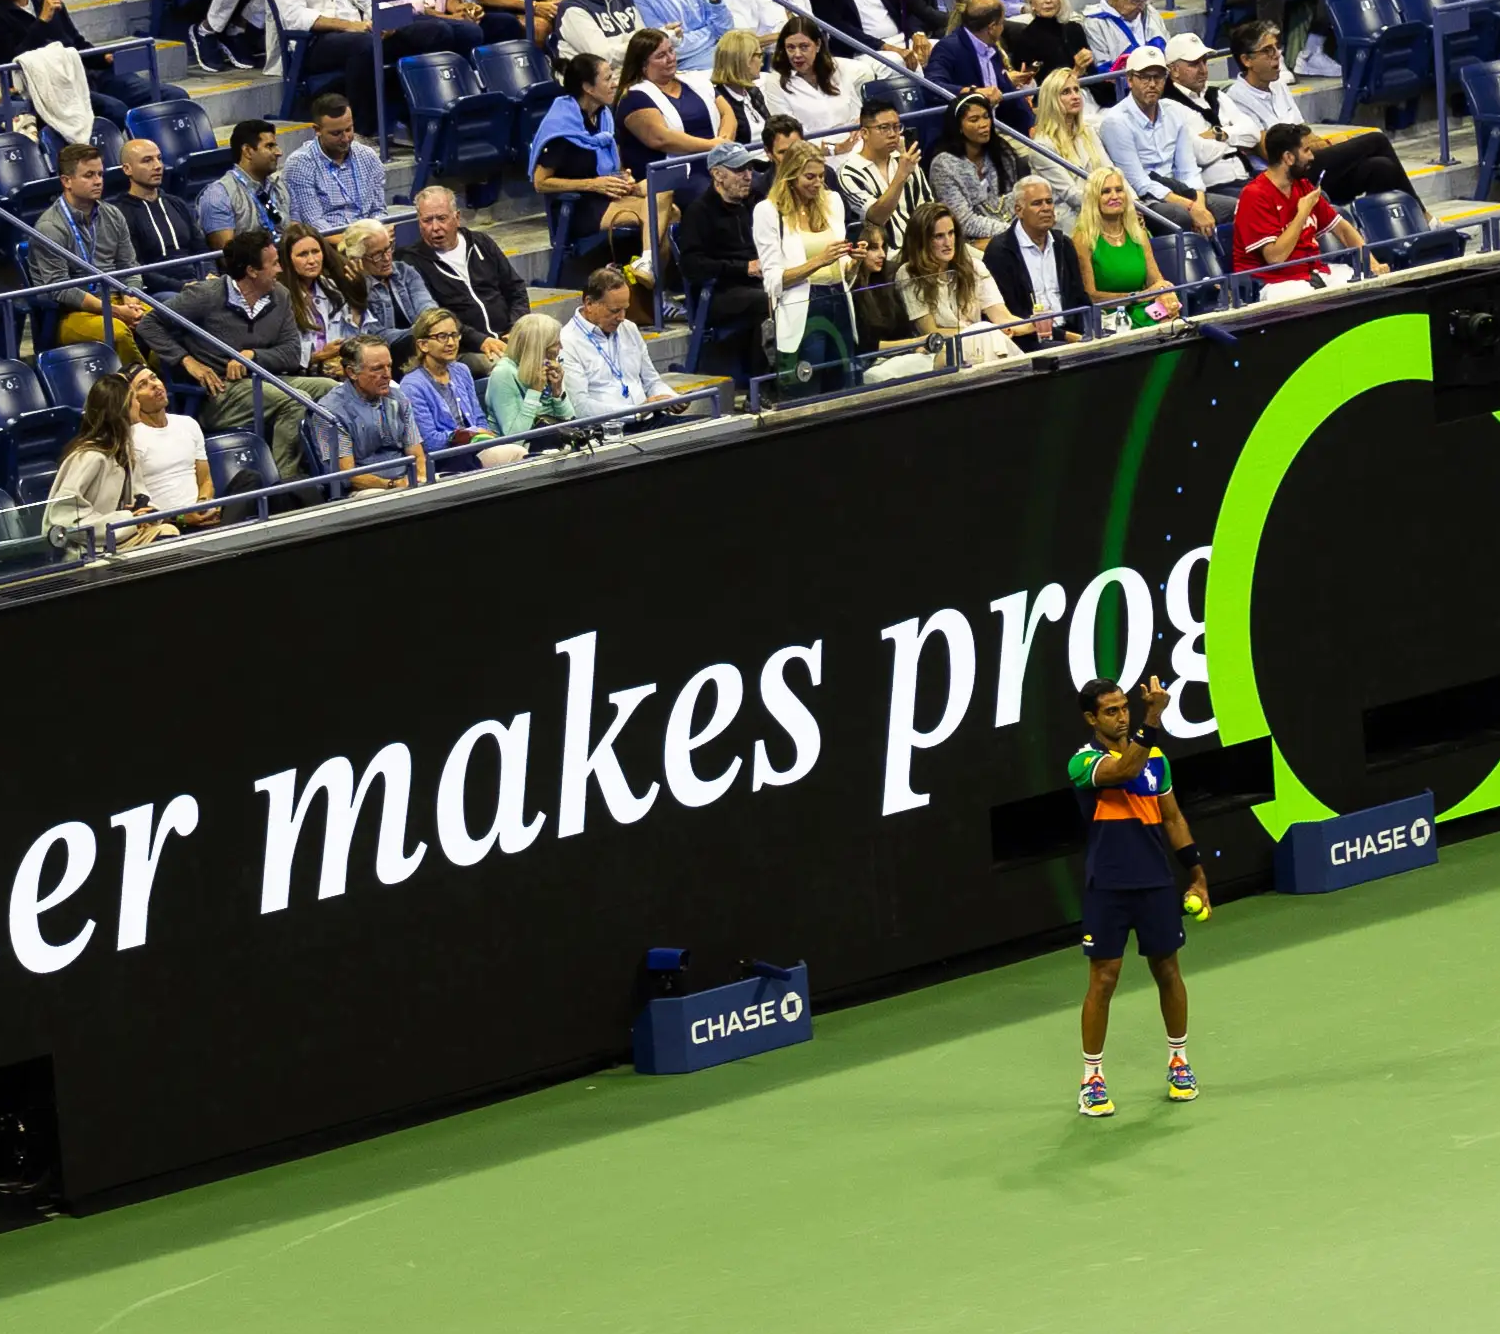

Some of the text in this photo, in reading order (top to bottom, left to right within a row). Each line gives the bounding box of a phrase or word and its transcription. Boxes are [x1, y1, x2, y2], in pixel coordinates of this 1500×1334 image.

[255, 630, 823, 915] makes
[1331, 826, 1408, 866] CHASE
[691, 1000, 777, 1045] CHASE
